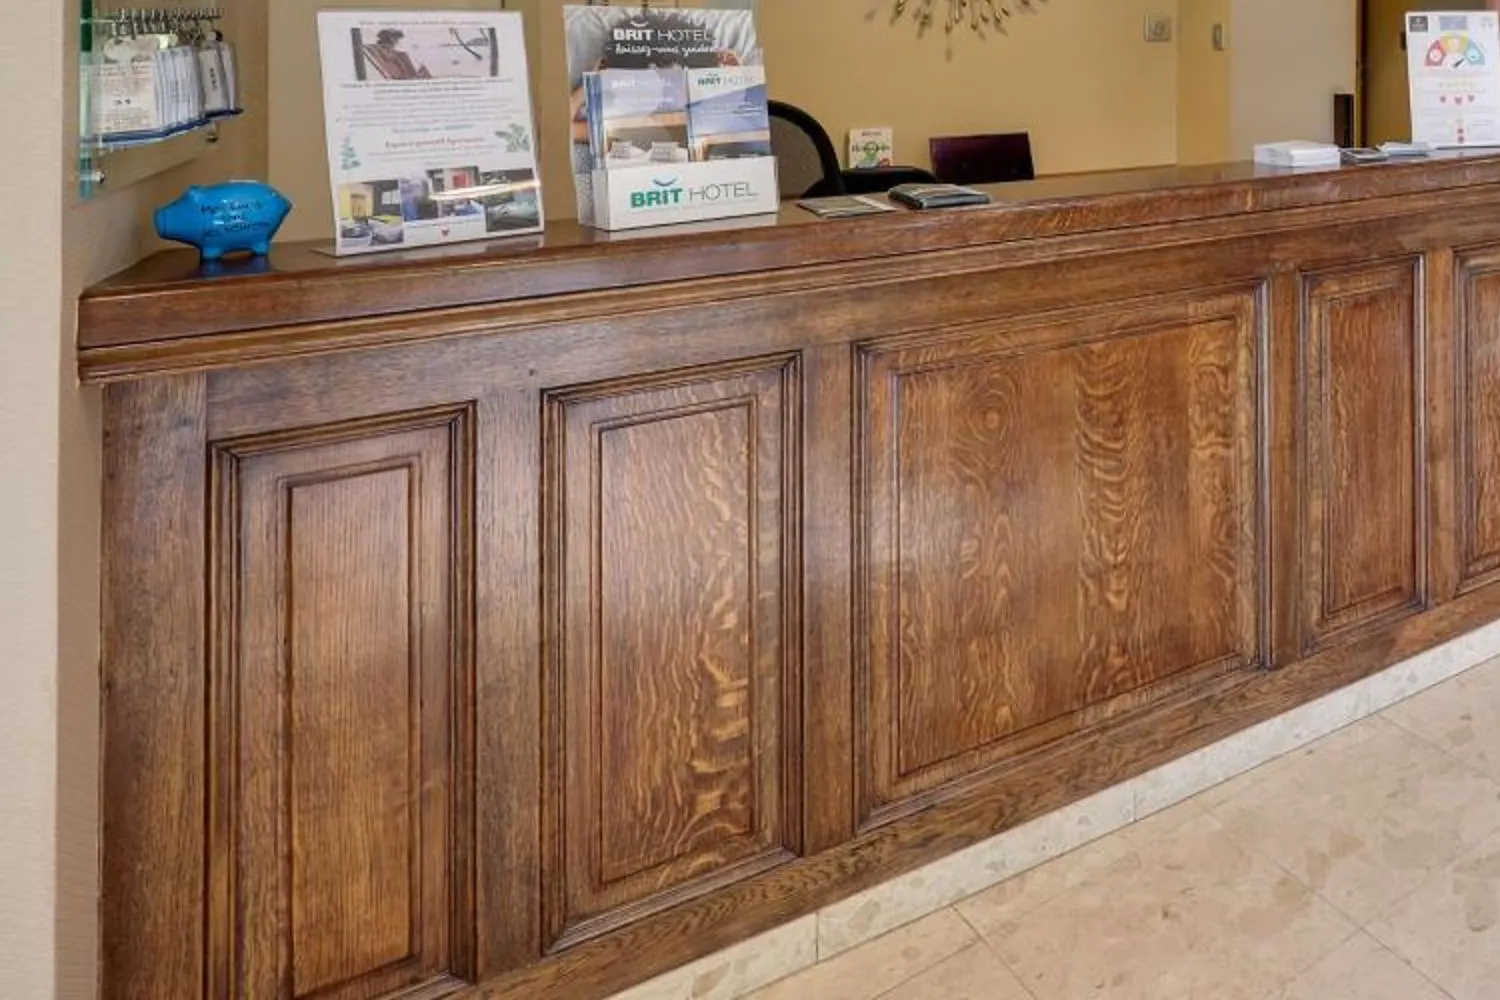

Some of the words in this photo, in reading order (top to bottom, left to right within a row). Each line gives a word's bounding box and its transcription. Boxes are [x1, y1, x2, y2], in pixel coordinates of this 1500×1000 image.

[613, 28, 653, 41] BRIT
[657, 27, 714, 41] HOTEL
[630, 187, 683, 209] BRIT
[689, 181, 760, 201] HOTEL
